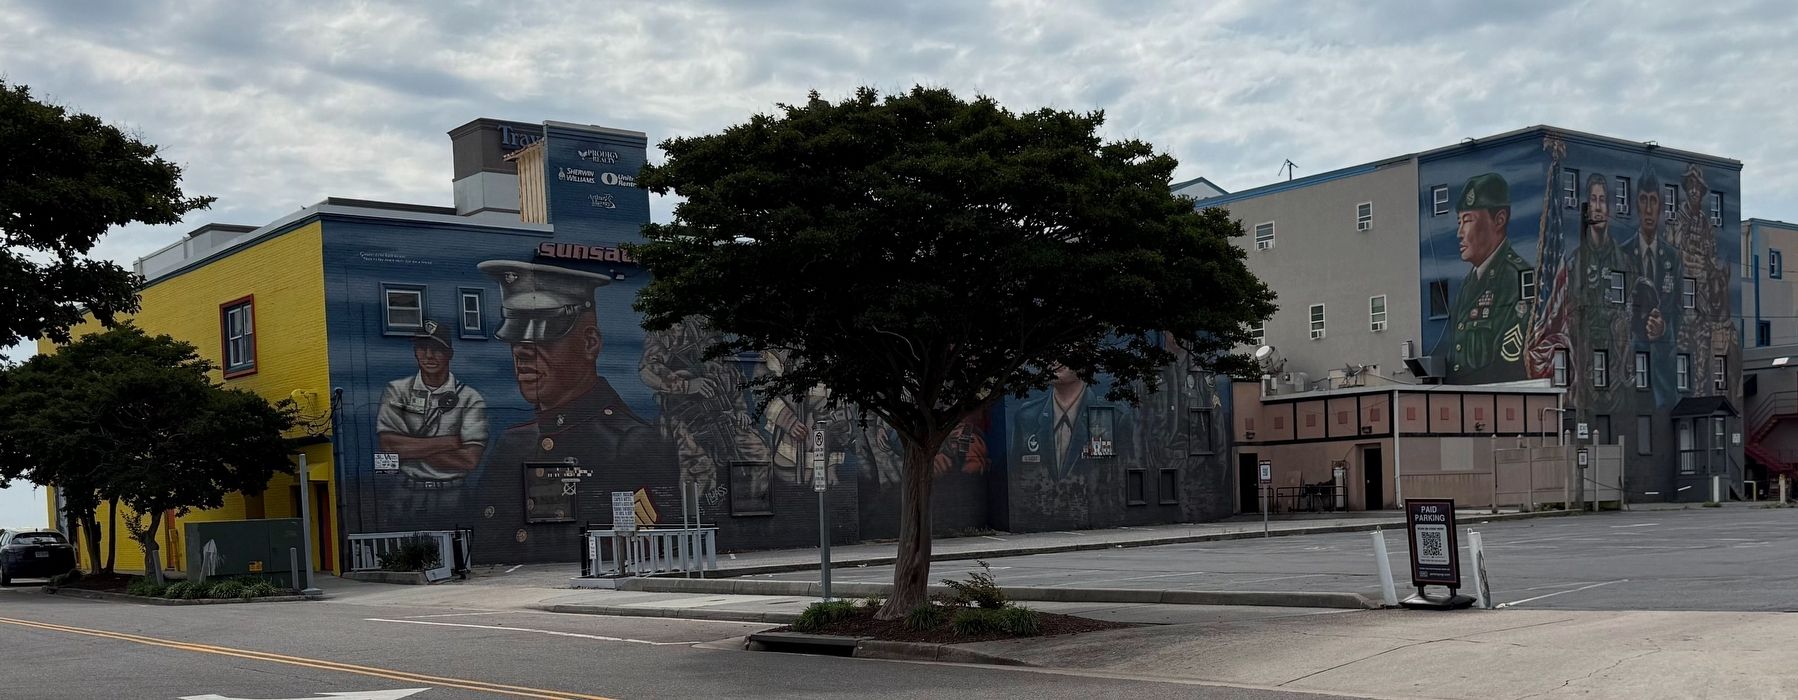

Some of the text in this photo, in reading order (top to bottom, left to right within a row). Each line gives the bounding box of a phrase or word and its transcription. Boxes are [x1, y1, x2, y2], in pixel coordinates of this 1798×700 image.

[566, 168, 595, 176] SHERWIN
[1420, 505, 1437, 513] PAID
[1414, 514, 1446, 522] PARKING
